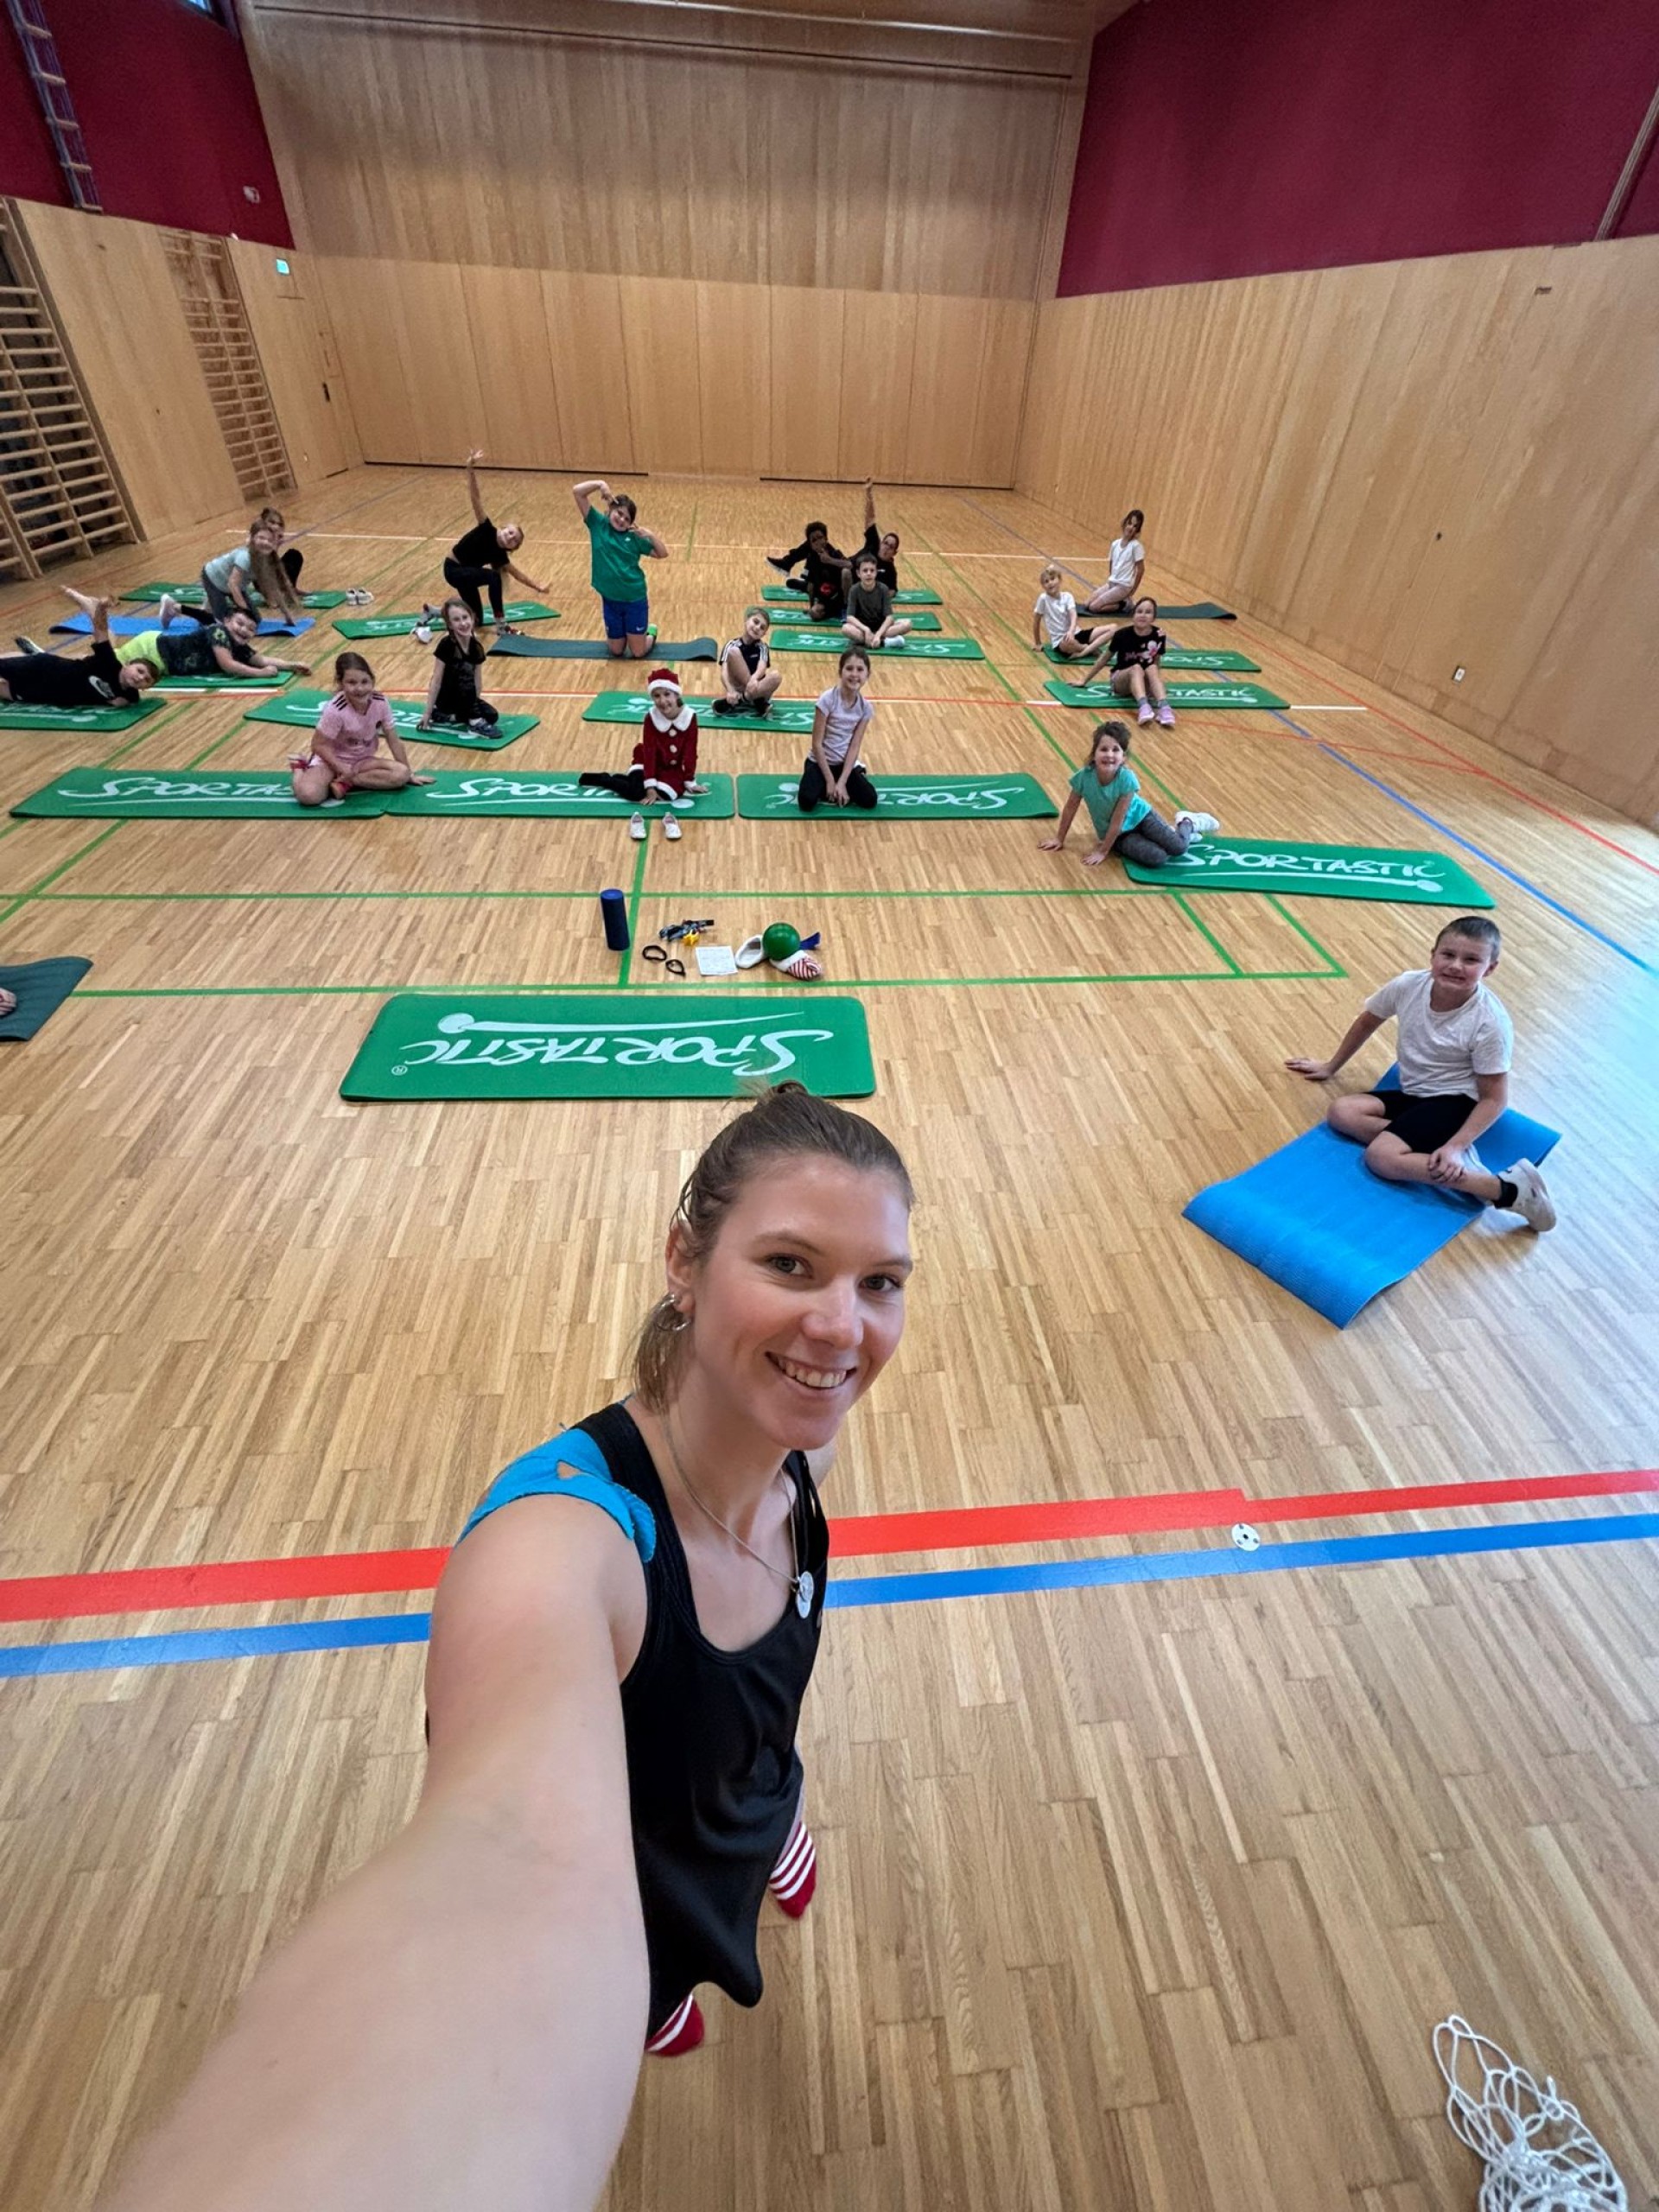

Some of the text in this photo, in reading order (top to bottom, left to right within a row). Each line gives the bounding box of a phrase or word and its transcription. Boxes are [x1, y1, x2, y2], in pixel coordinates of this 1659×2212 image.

[1076, 685, 1252, 697] STASTIC
[1164, 843, 1446, 878] SPORTASTIC
[399, 1028, 834, 1077] SPORTASTIC
